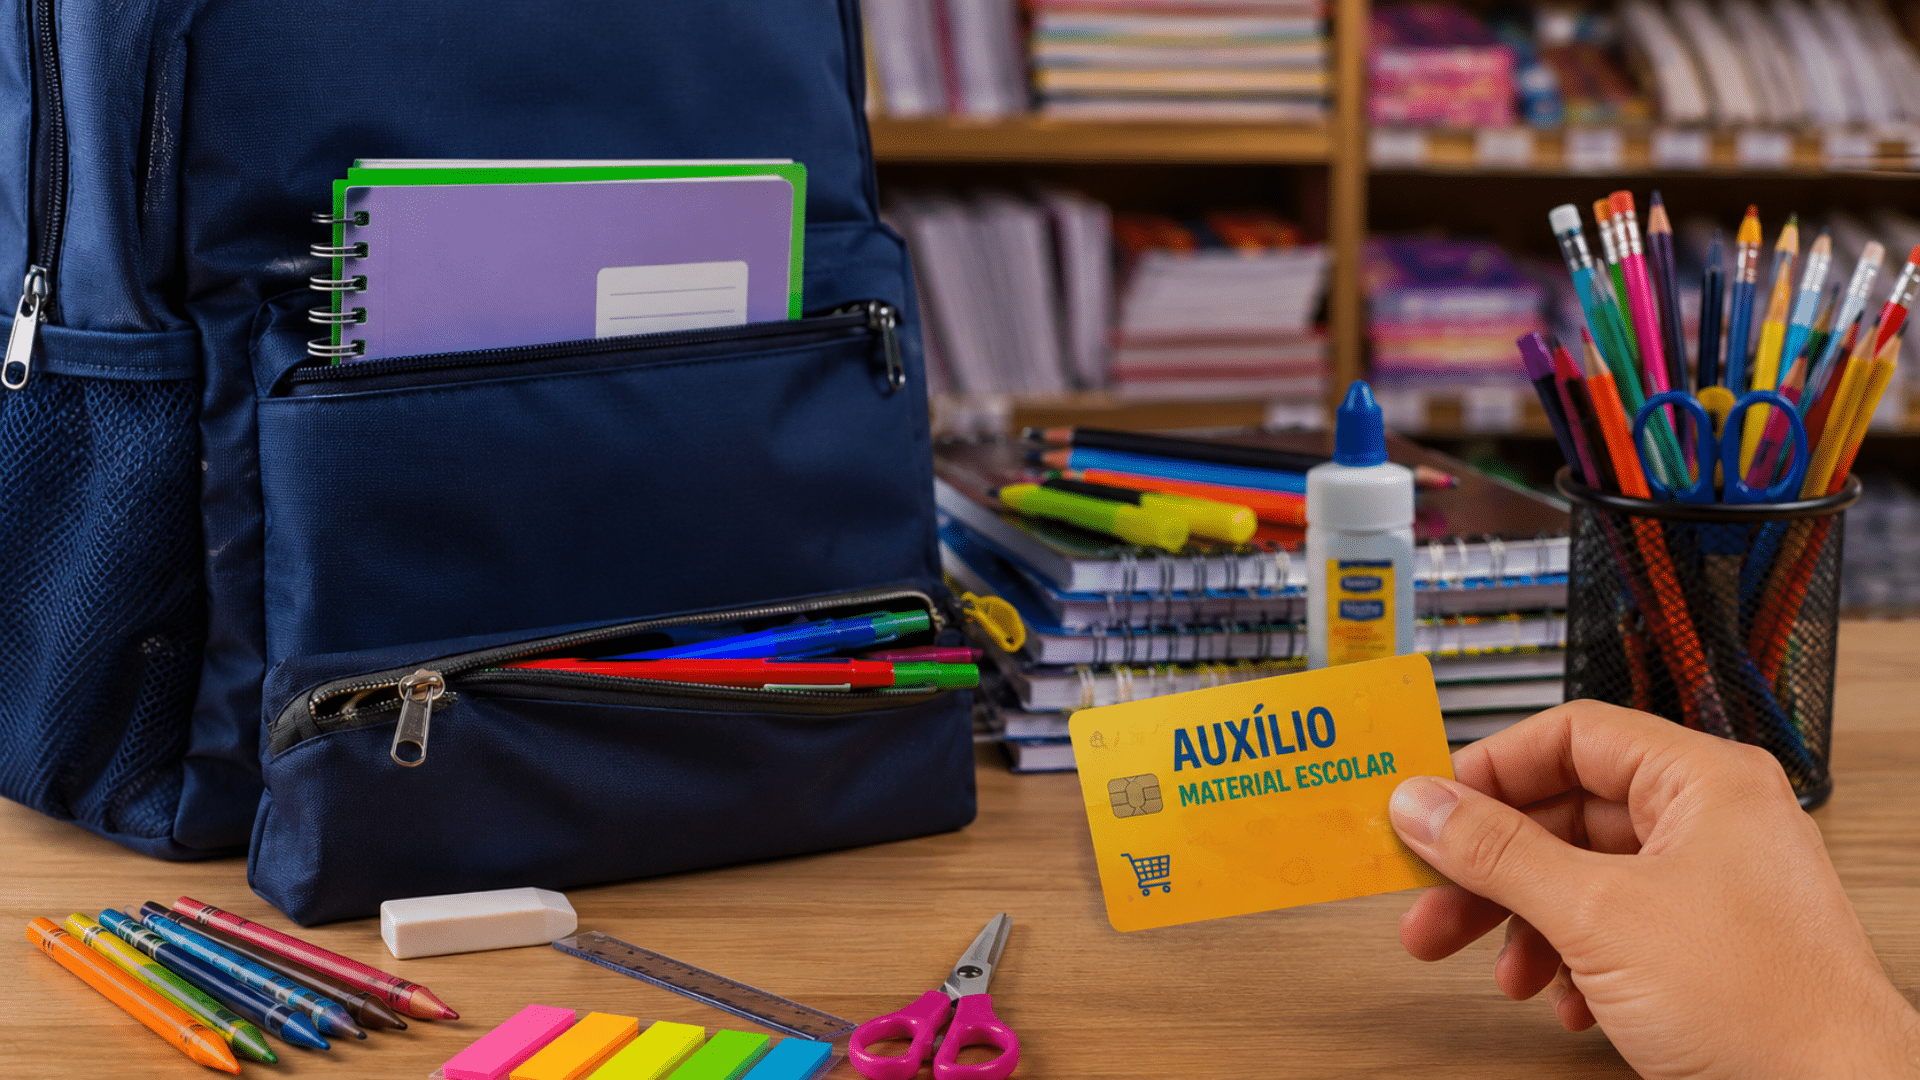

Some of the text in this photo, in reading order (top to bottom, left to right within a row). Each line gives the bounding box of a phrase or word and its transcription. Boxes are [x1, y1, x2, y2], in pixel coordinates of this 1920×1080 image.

[1174, 704, 1336, 771] AUXÍLIO
[1178, 752, 1397, 807] MATERIAL ESCOLAR
